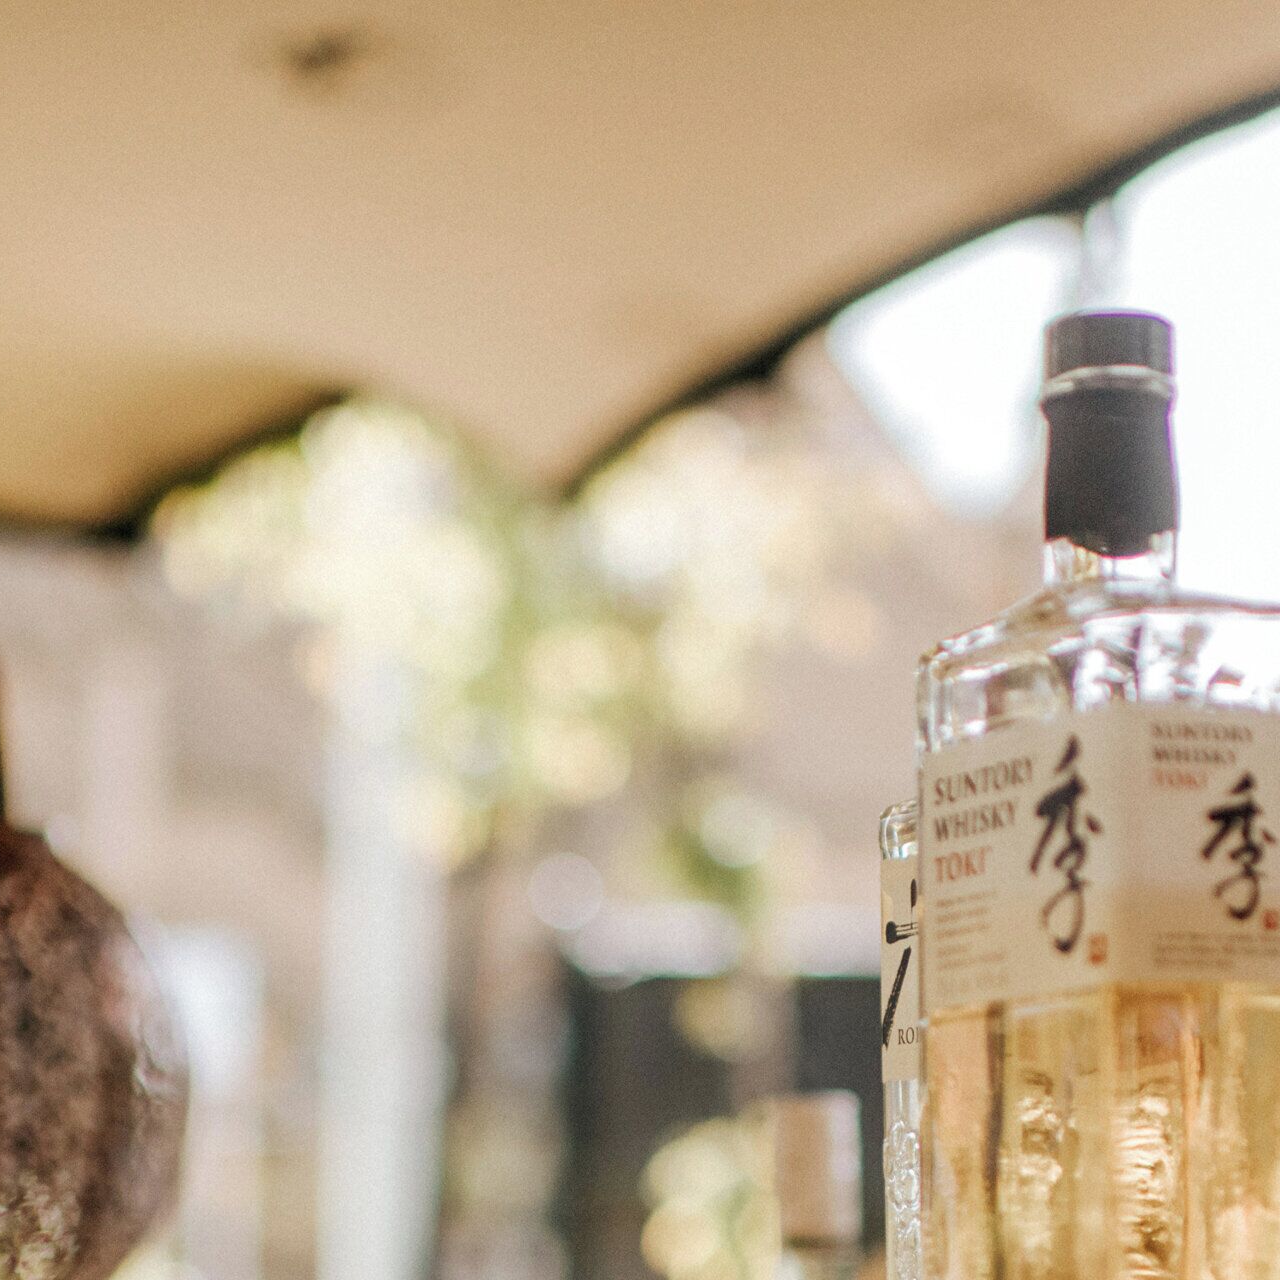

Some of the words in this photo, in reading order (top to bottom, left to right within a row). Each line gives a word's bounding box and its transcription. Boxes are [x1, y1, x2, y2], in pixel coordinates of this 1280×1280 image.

[933, 757, 1034, 806] SUNTORY
[933, 801, 1017, 843] WHISKY
[934, 845, 991, 884] TOKI
